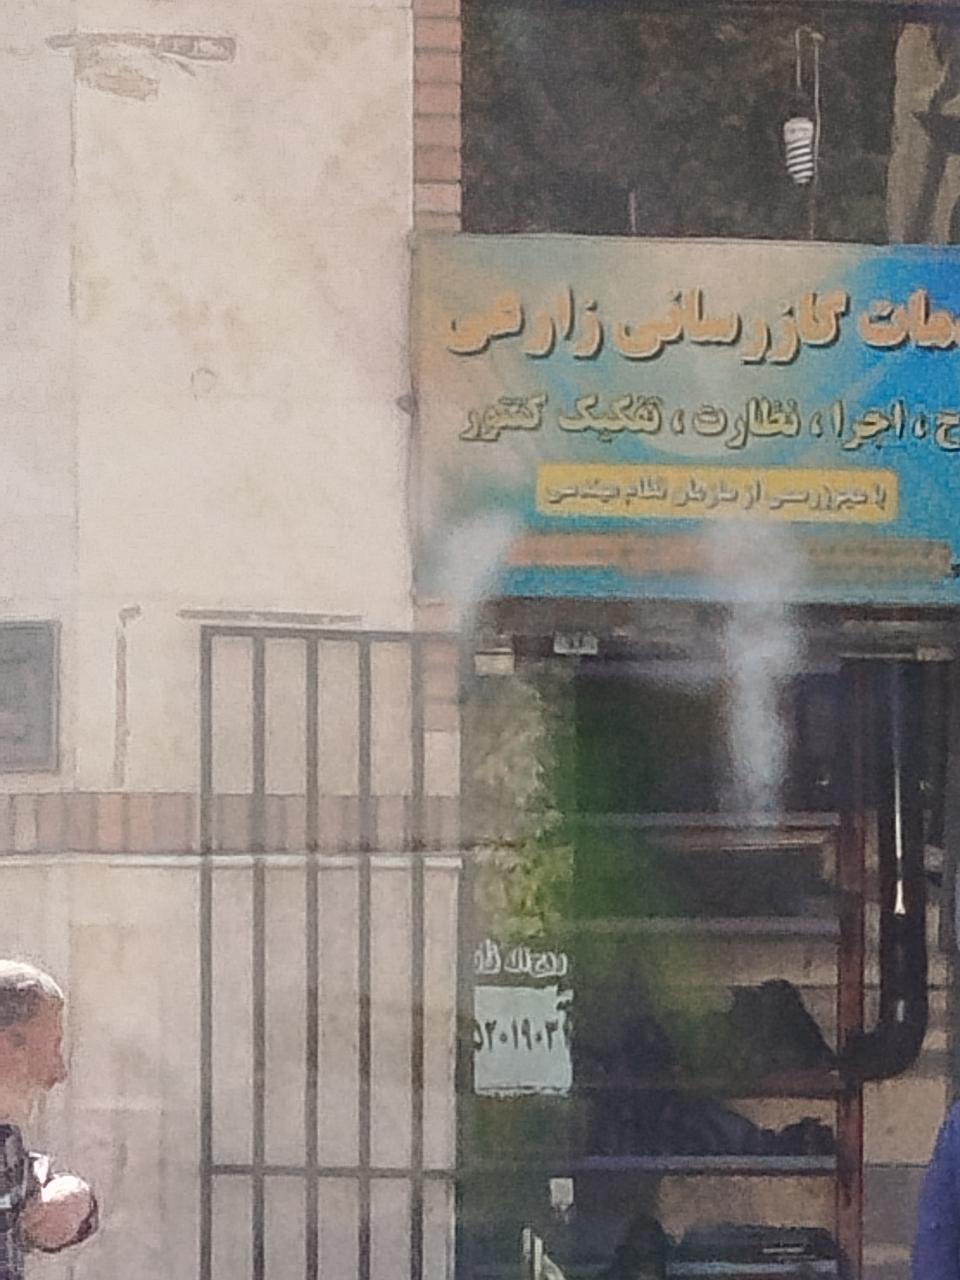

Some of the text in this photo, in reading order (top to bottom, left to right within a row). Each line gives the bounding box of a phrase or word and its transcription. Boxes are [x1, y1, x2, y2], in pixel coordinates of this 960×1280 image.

[447, 284, 605, 359] زارعی
[458, 393, 548, 442] کنتور
[557, 393, 662, 442] تفکیک
